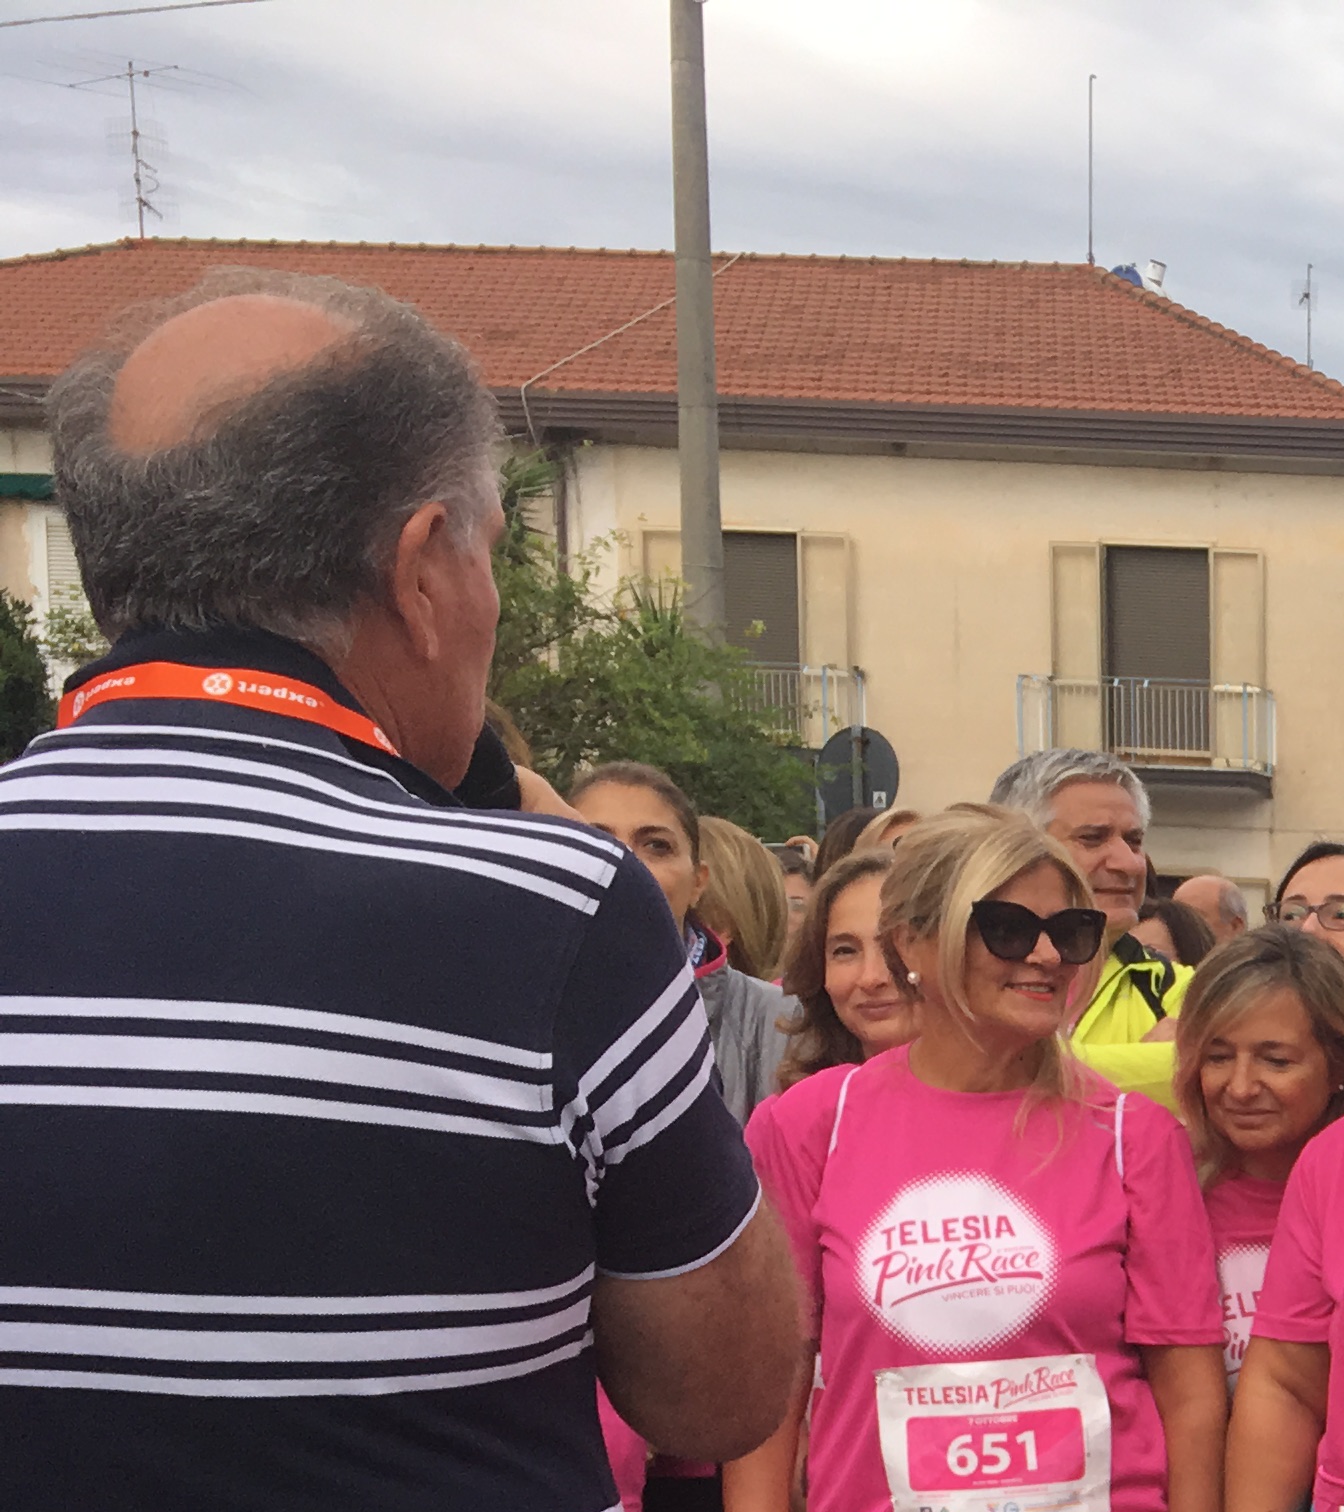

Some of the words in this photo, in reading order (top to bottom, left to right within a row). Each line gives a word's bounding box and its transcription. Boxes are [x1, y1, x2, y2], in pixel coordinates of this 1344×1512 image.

[237, 679, 319, 709] expert
[880, 1215, 1016, 1251] TELESIA
[872, 1248, 956, 1310] Pink
[957, 1243, 1040, 1284] Race
[942, 1287, 991, 1303] VINCERE
[993, 1285, 1005, 1297] SI
[904, 1384, 990, 1407] TELESIA
[990, 1373, 1034, 1410] Pink
[1034, 1366, 1076, 1392] Race
[946, 1430, 1039, 1477] 651
